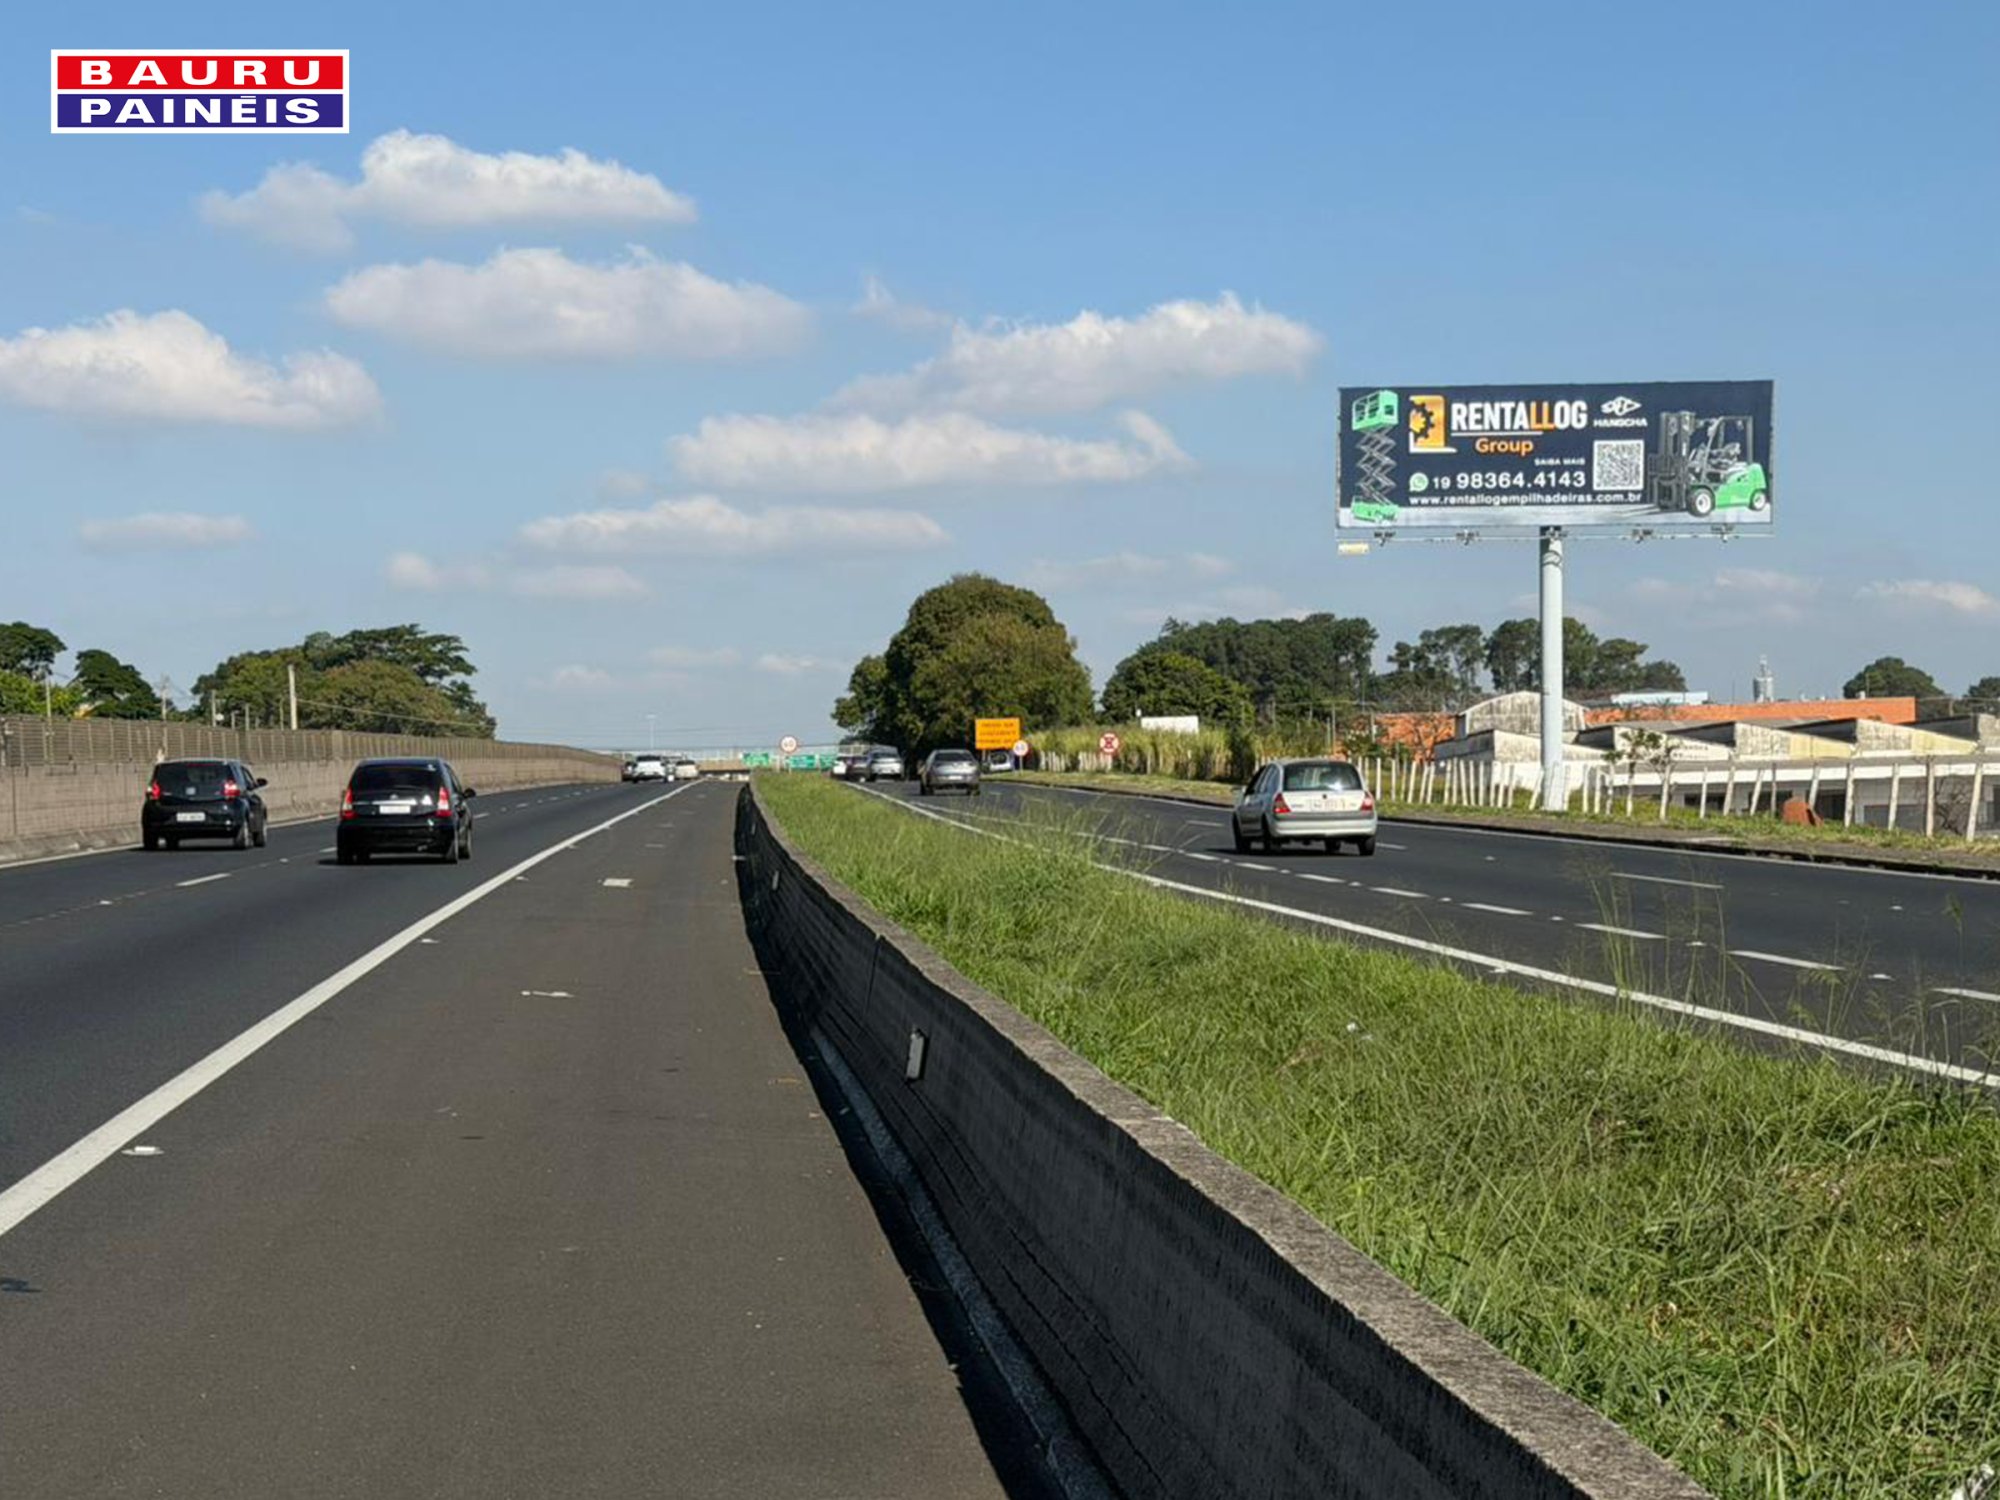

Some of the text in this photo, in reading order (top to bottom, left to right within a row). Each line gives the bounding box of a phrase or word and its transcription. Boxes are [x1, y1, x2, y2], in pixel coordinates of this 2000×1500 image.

[1451, 400, 1588, 431] RENTALLOG
[1475, 437, 1534, 457] Group
[1534, 457, 1586, 466] SAIBA MAIS
[1433, 470, 1586, 489] 19 98364.4143
[1409, 492, 1642, 506] www.rentallogempilhadeiras.com.br
